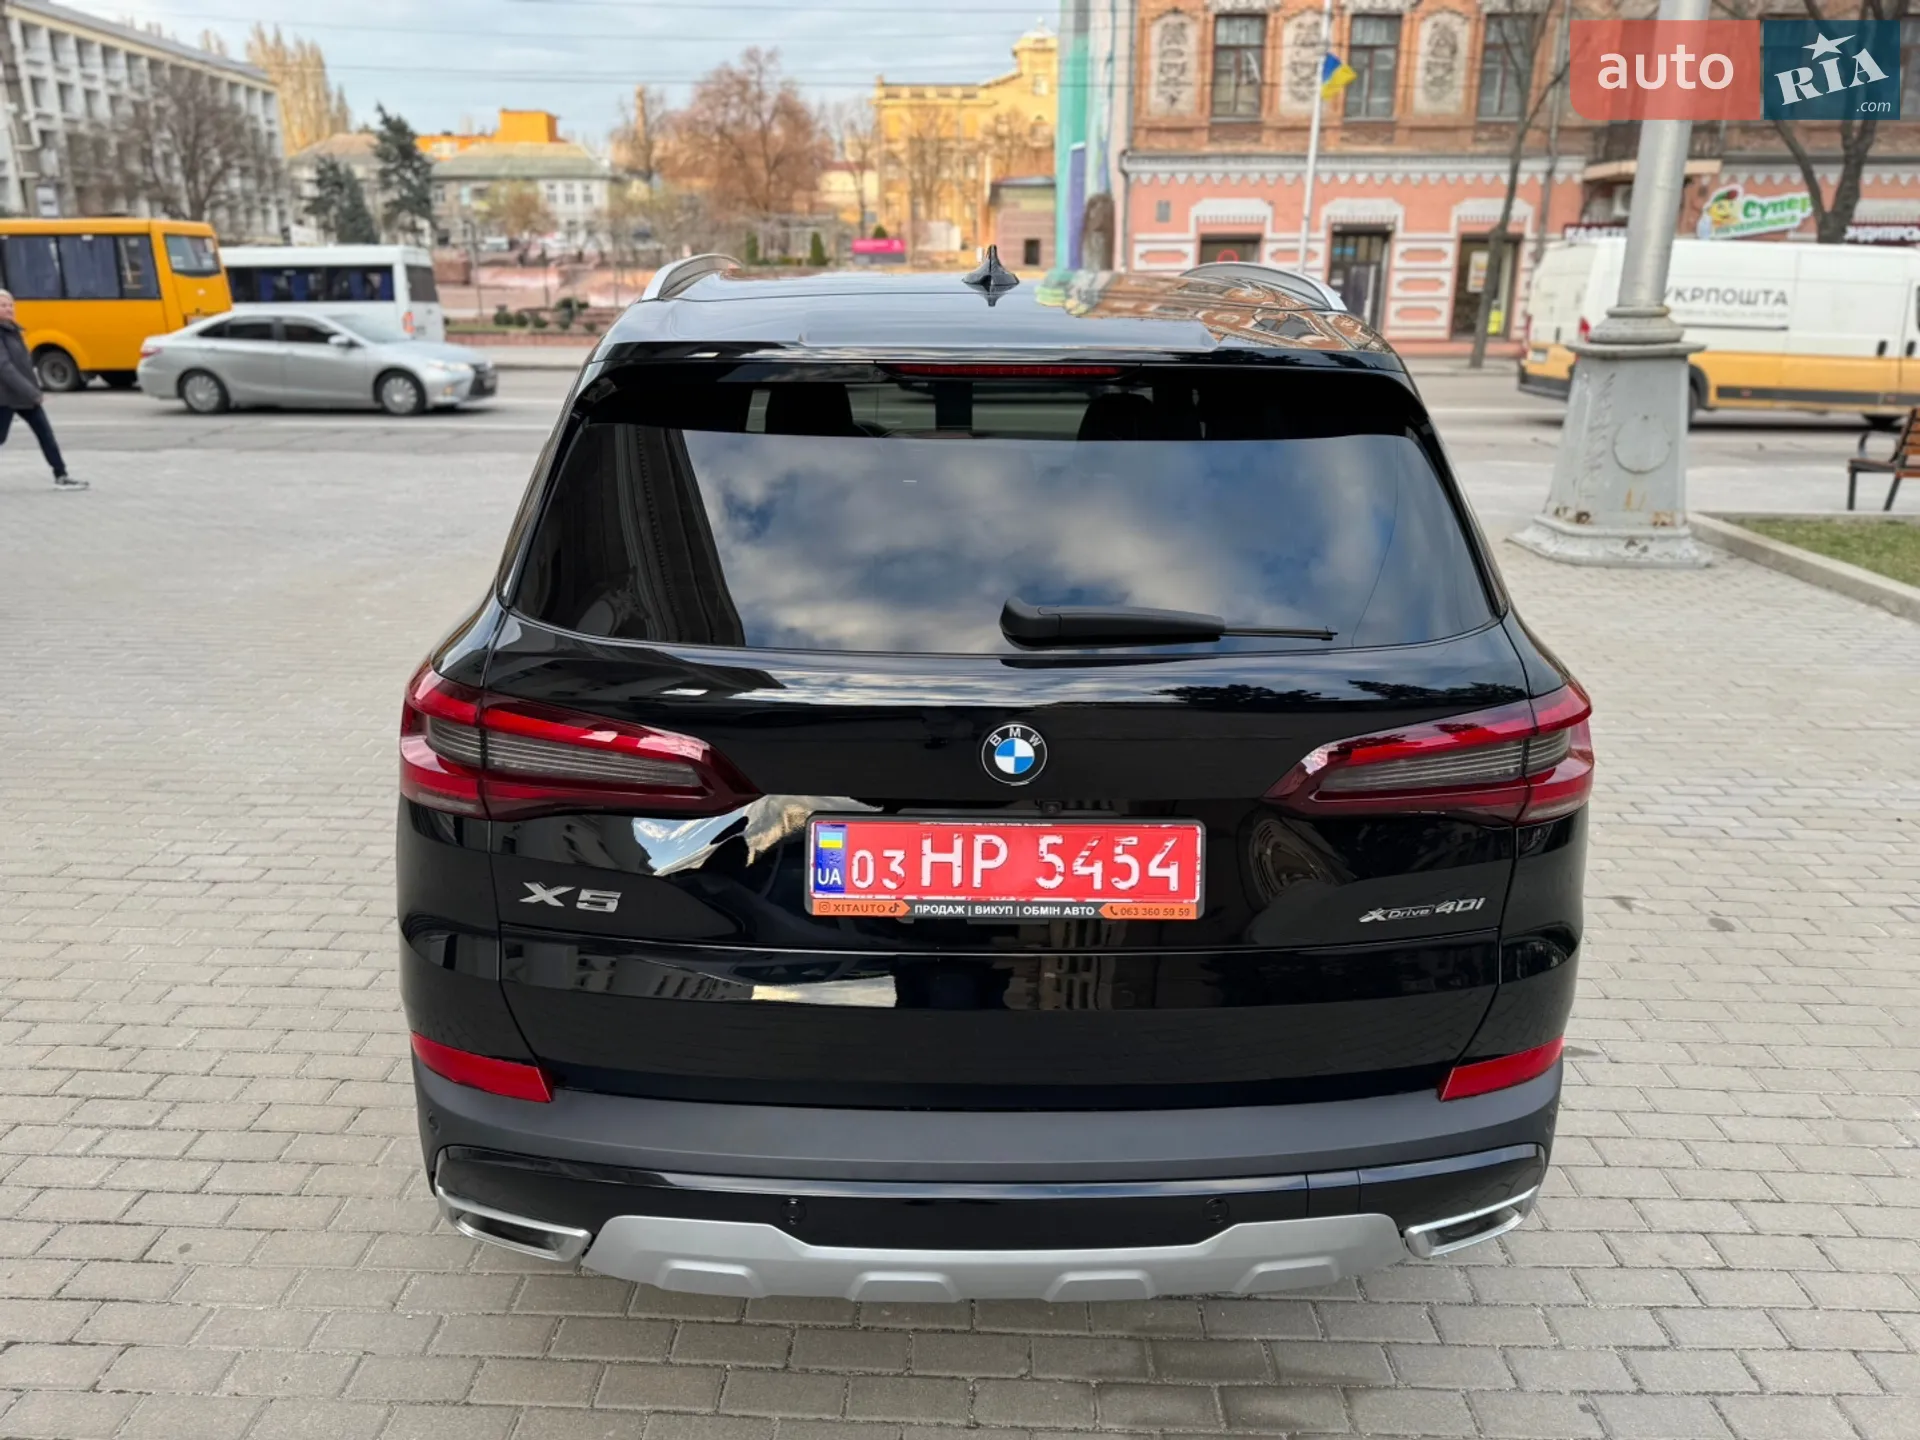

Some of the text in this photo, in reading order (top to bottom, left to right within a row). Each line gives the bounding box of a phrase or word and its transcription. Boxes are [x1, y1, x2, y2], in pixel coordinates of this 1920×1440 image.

[989, 727, 1042, 747] BMW
[851, 833, 1179, 892] 03 HP 5454
[817, 868, 842, 885] UA
[519, 881, 622, 913] X5
[833, 903, 886, 913] XITAUTO
[914, 904, 1095, 916] ПРОДАЖ ВИКУП ОБМІН АВТО
[1120, 908, 1139, 917] 063
[1163, 908, 1175, 917] 59
[1178, 908, 1191, 917] 59
